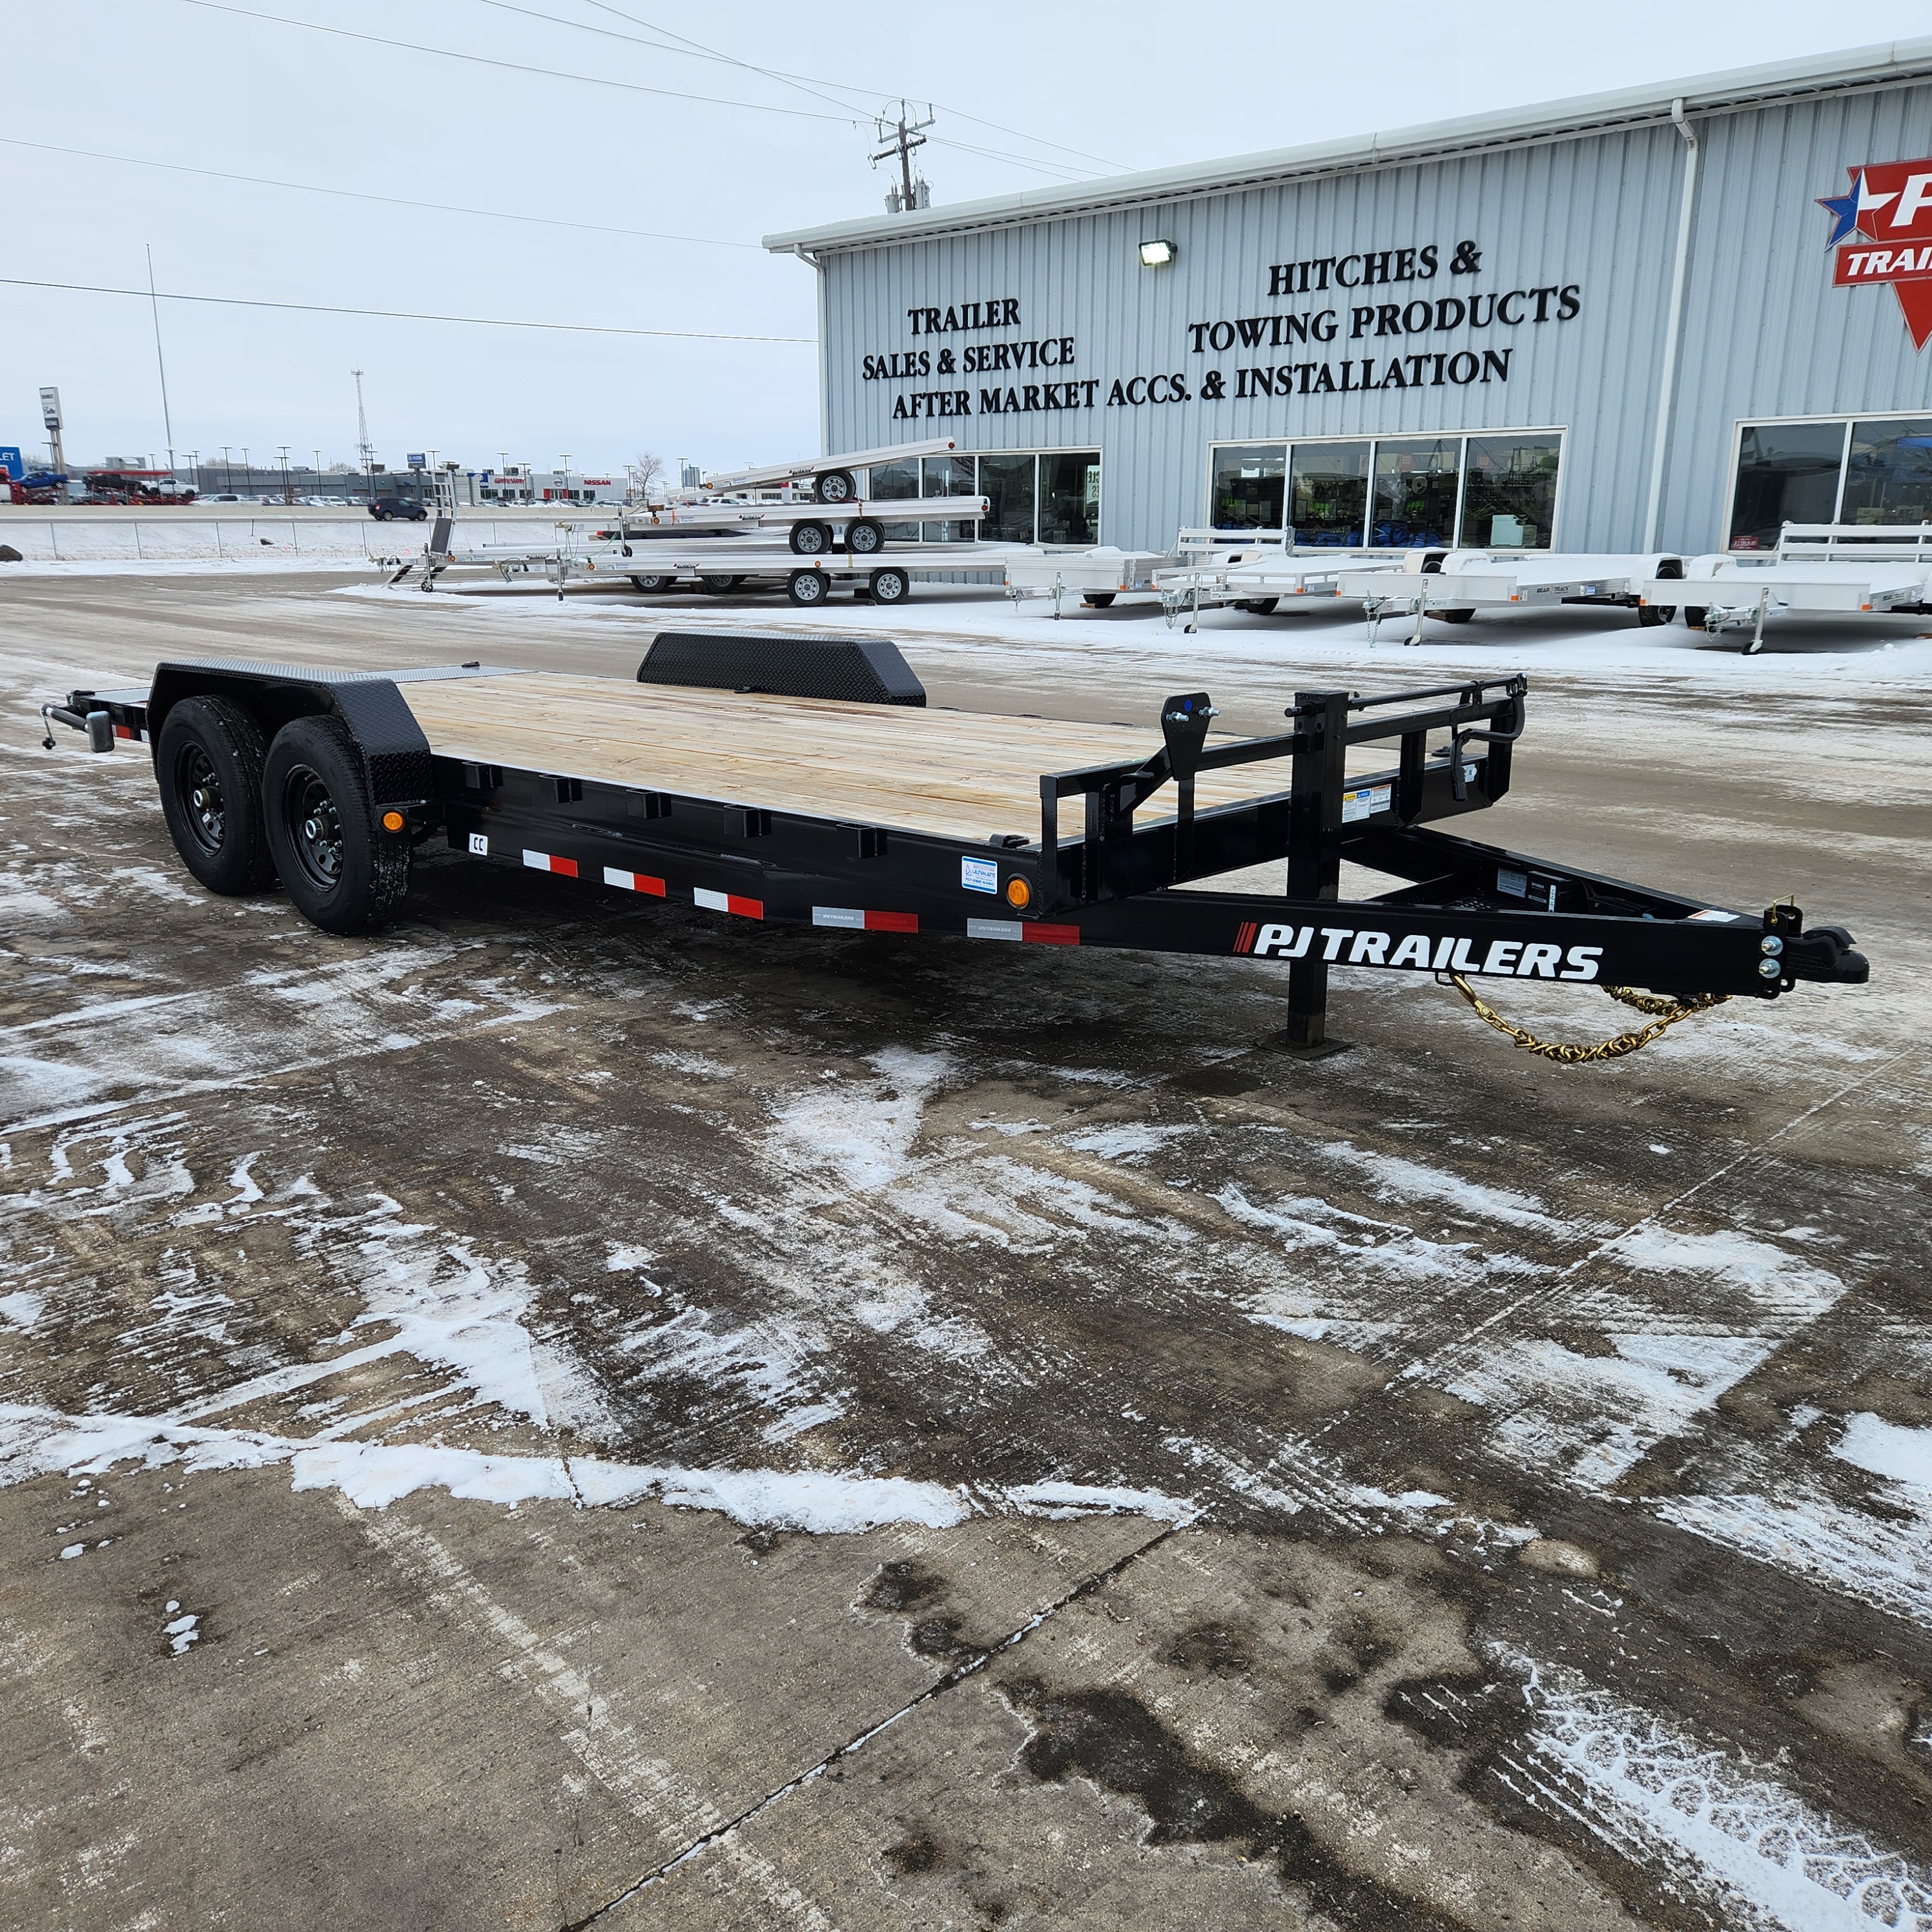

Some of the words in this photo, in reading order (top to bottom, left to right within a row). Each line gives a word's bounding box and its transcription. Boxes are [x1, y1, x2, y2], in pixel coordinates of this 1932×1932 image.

[1267, 245, 1438, 296] HITCHES
[1449, 240, 1483, 276] &
[907, 298, 1021, 336] TRAILER
[1187, 309, 1339, 353] TOWING
[1349, 285, 1580, 339] PRODUCTS
[862, 351, 930, 381] SALES
[936, 348, 957, 375] &
[962, 336, 1074, 374] SERVICE
[892, 390, 972, 420] AFTER
[978, 378, 1100, 415] MARKET
[1105, 373, 1192, 406] ACCS.
[1200, 370, 1226, 400] &
[1235, 348, 1514, 398] INSTALLATION
[1253, 923, 1315, 958] PJ
[1321, 928, 1603, 980] TRAILERS
